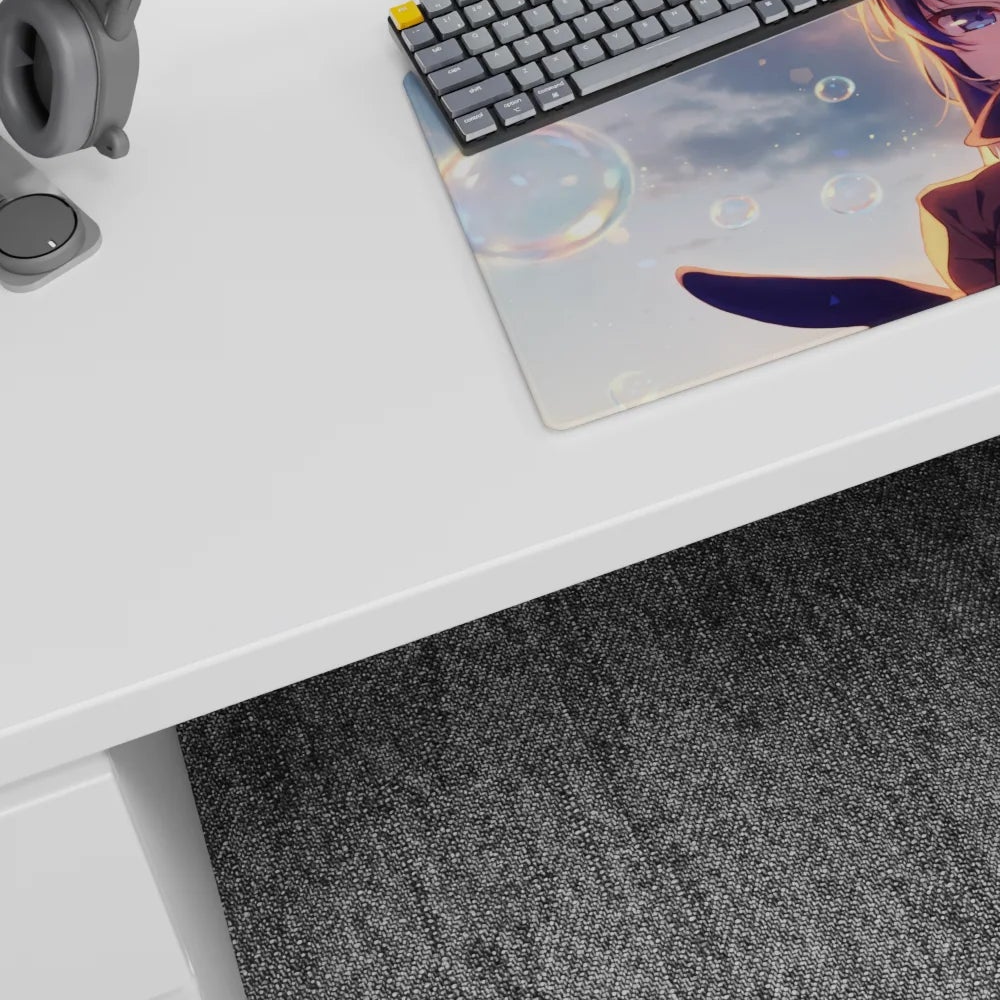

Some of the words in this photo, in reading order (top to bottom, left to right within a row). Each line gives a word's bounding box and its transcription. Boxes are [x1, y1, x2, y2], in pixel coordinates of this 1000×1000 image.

[447, 66, 462, 75] caps
[468, 85, 482, 94] shift
[537, 80, 565, 95] command
[503, 98, 522, 109] option
[463, 112, 484, 124] control
